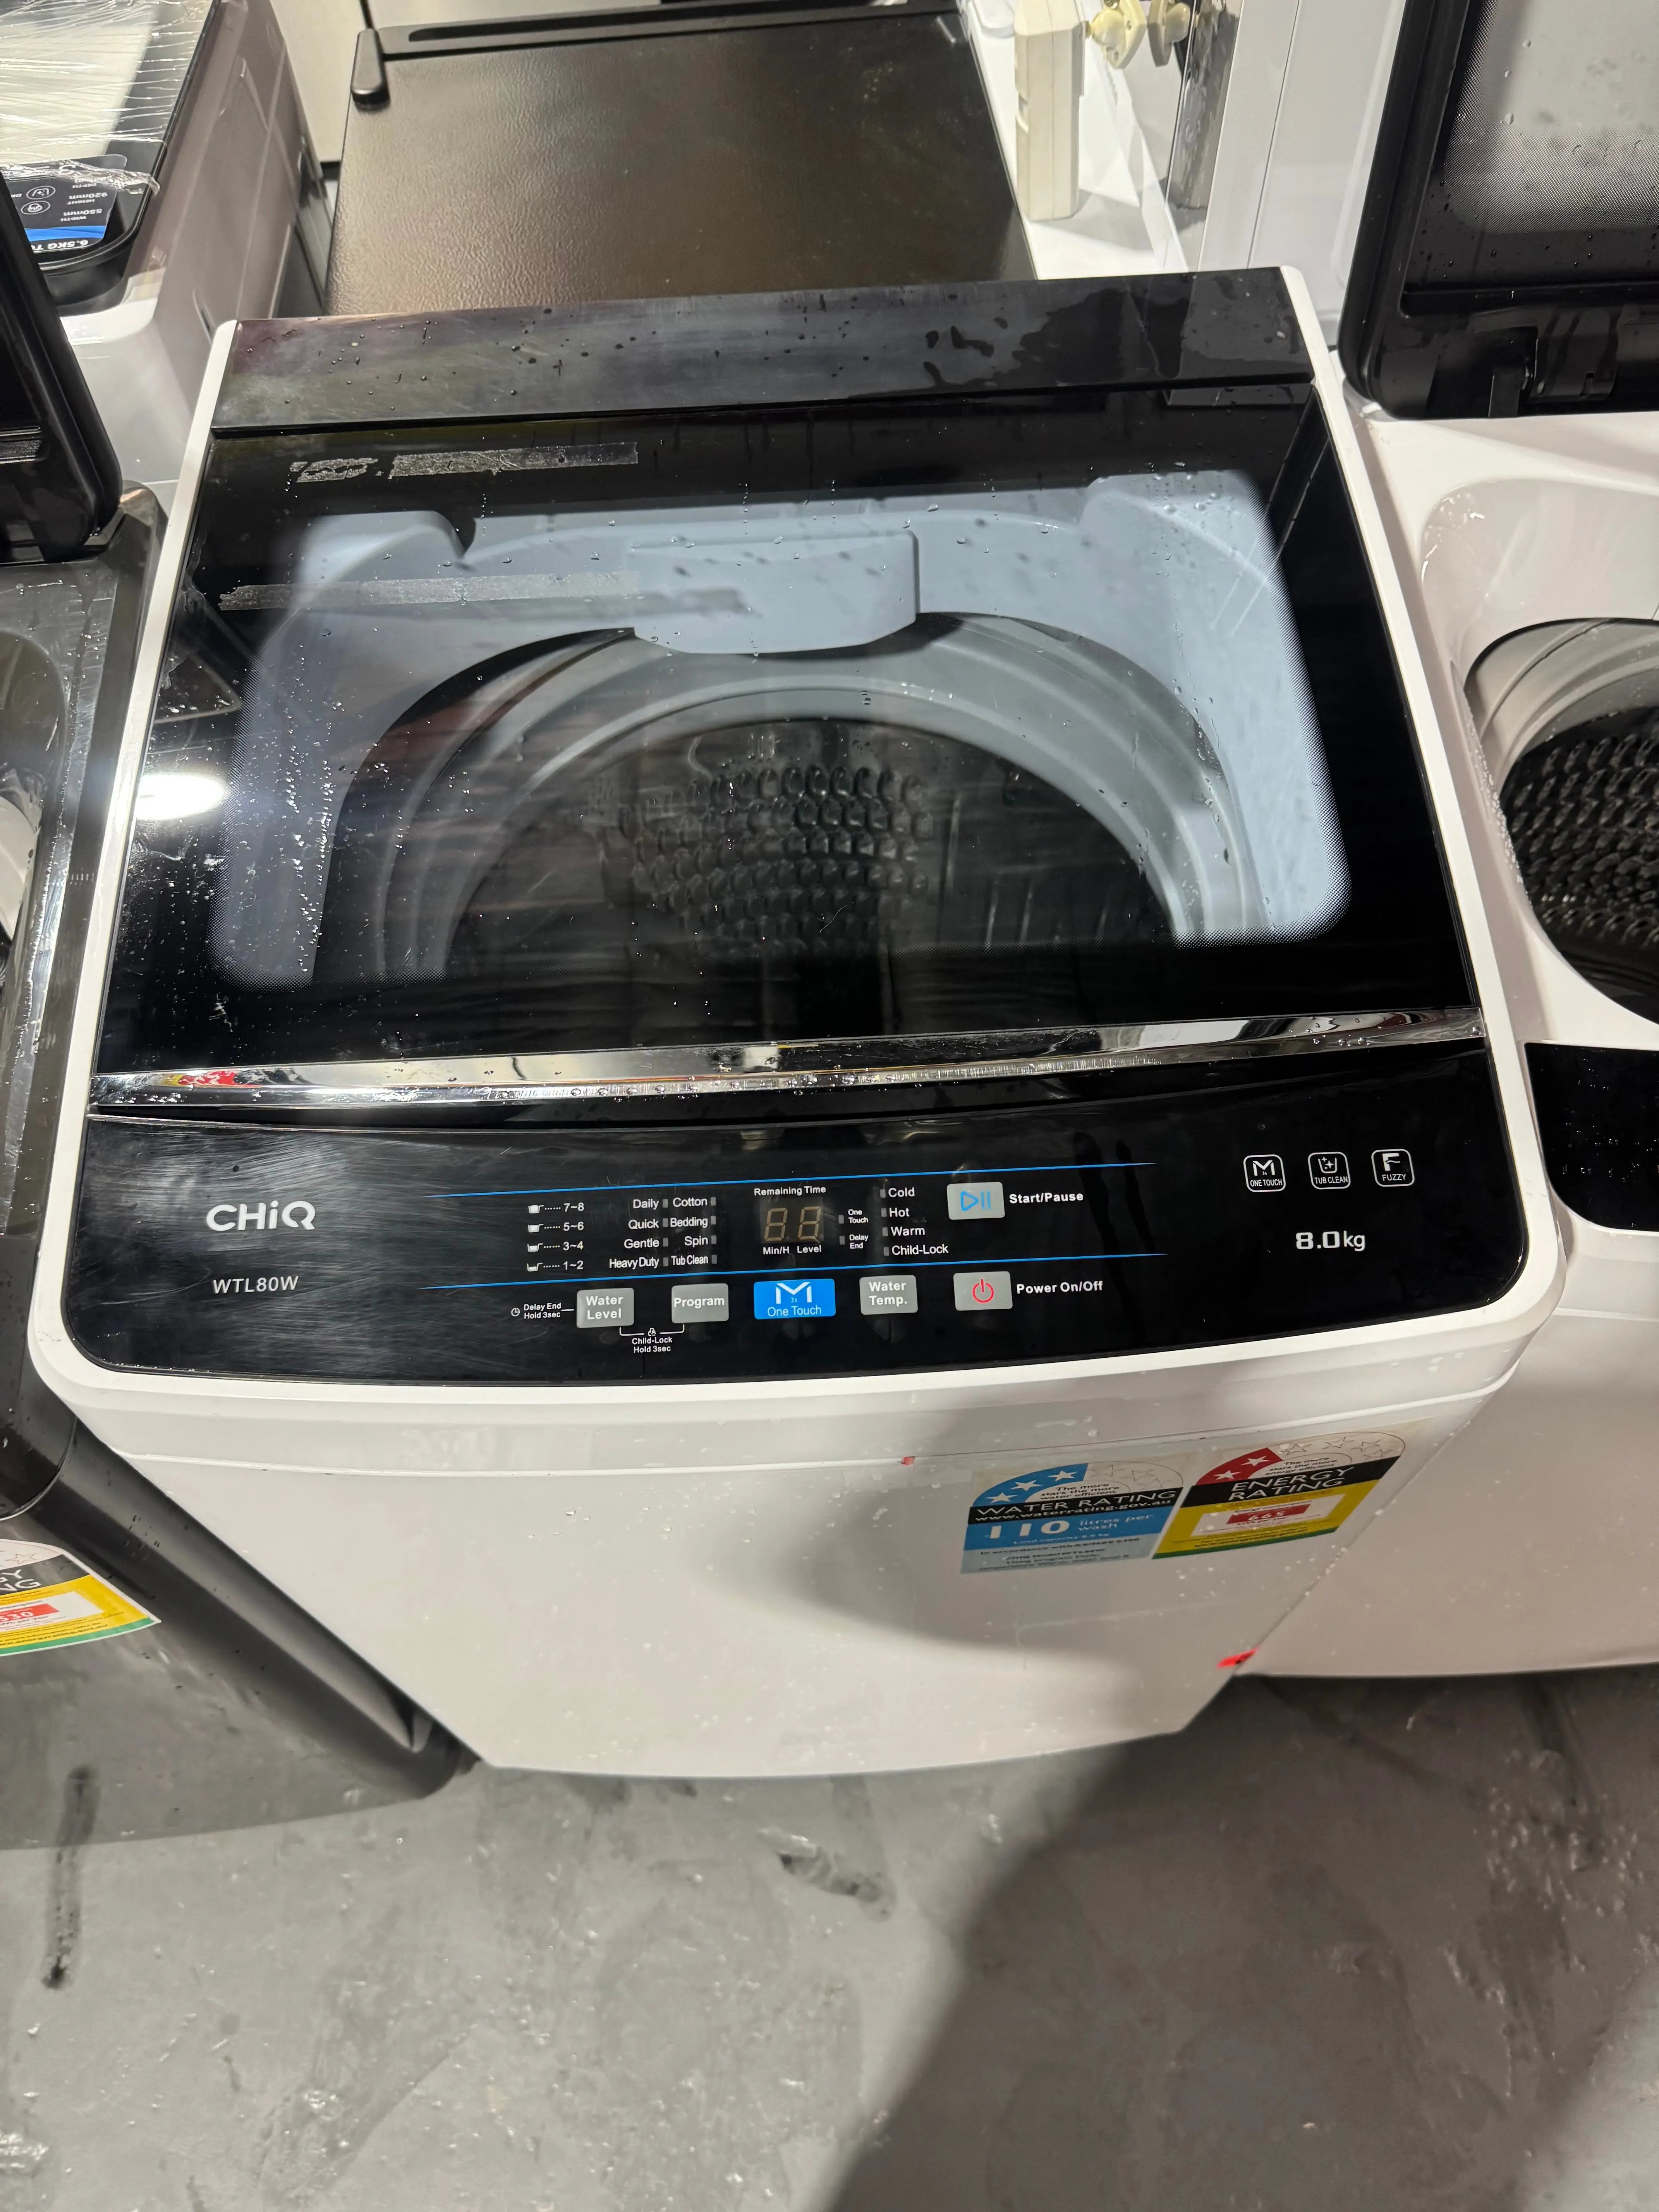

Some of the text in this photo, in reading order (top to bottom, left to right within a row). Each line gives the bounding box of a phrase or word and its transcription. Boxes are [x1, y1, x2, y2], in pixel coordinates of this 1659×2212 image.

[48, 240, 89, 249] 6.5KG
[1328, 1175, 1349, 1183] CLEAN
[754, 1187, 802, 1196] Remaining
[888, 1187, 915, 1197] Cold
[673, 1197, 708, 1207] Cotton
[1009, 1192, 1083, 1204] Start/Pause
[633, 1198, 659, 1210] Daily
[206, 1200, 316, 1231] CHiQ
[889, 1207, 910, 1217] Hot
[628, 1218, 659, 1230] Quick
[670, 1216, 708, 1228] Bedding
[890, 1226, 925, 1236] Warm
[624, 1238, 659, 1249] Gentle
[684, 1235, 708, 1248] Spin
[849, 1234, 869, 1242] Delay
[763, 1246, 790, 1255] Min/H
[797, 1245, 821, 1253] Level
[891, 1243, 949, 1255] Child-Lock
[213, 1275, 299, 1294] WTL80W
[869, 1281, 906, 1292] Water
[1017, 1280, 1103, 1294] Power On/Off
[586, 1295, 623, 1306] Water
[673, 1297, 725, 1308] Program
[869, 1295, 907, 1307] Temp.
[587, 1309, 621, 1320] Level
[767, 1305, 822, 1317] One Touch
[632, 1336, 673, 1345] Child-Lock
[1230, 1467, 1355, 1492] ENERGY
[1228, 1477, 1345, 1501] RATING
[977, 1491, 1177, 1515] WATER RATING
[975, 1499, 1171, 1522] www.waterrating.gov.au
[1080, 1514, 1154, 1526] litres per
[1078, 1522, 1118, 1531] wash
